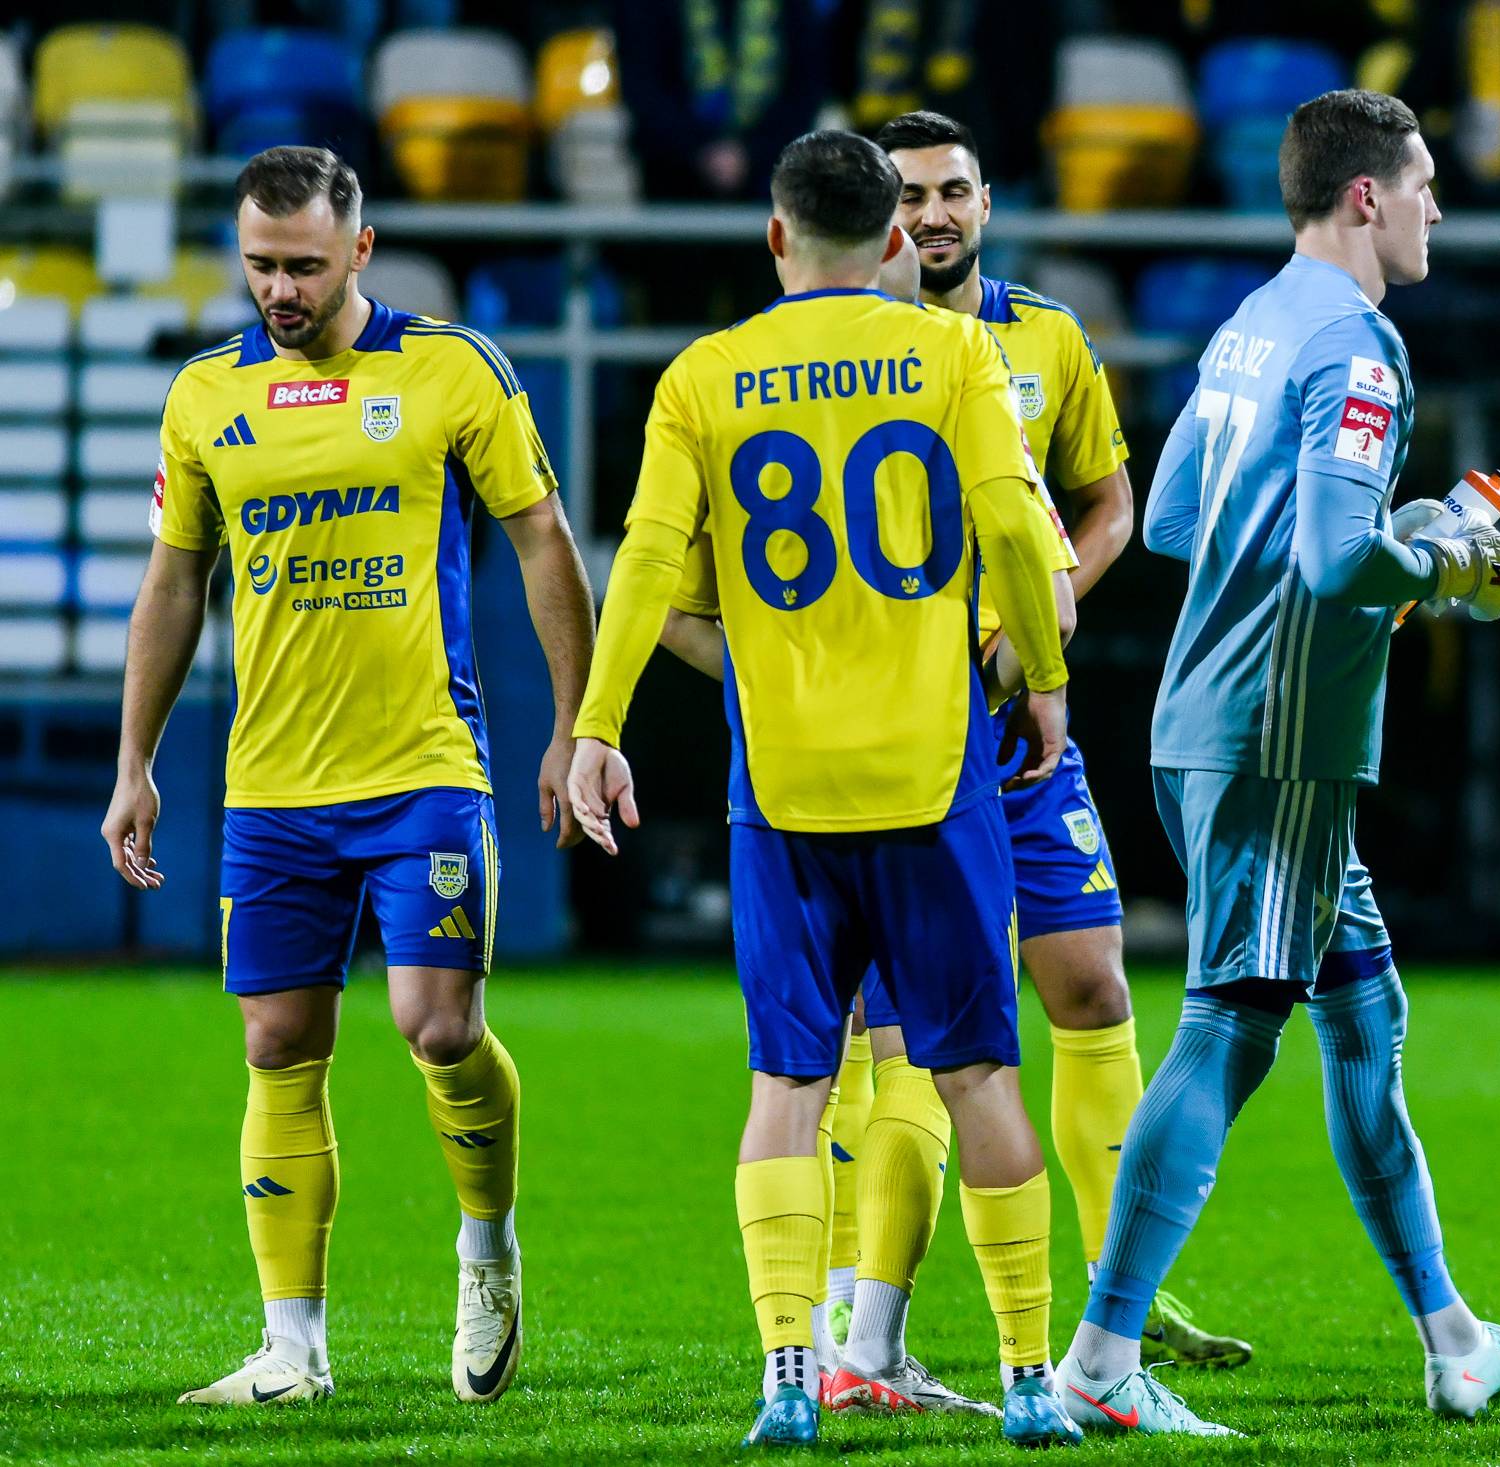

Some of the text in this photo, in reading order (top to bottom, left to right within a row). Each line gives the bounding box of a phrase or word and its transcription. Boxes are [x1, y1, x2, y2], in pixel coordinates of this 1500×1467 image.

[734, 347, 923, 409] PETROVIĆ
[1355, 380, 1393, 400] SUZUKI
[272, 382, 343, 405] Betclic
[1345, 406, 1387, 431] Betclic
[1191, 388, 1258, 576] 77
[240, 485, 400, 536] GDYNIA
[730, 418, 964, 612] 80
[288, 554, 404, 587] Energa
[292, 591, 403, 612] GRUPA ORLEN
[775, 1315, 796, 1326] 80
[1002, 1334, 1017, 1346] 80
